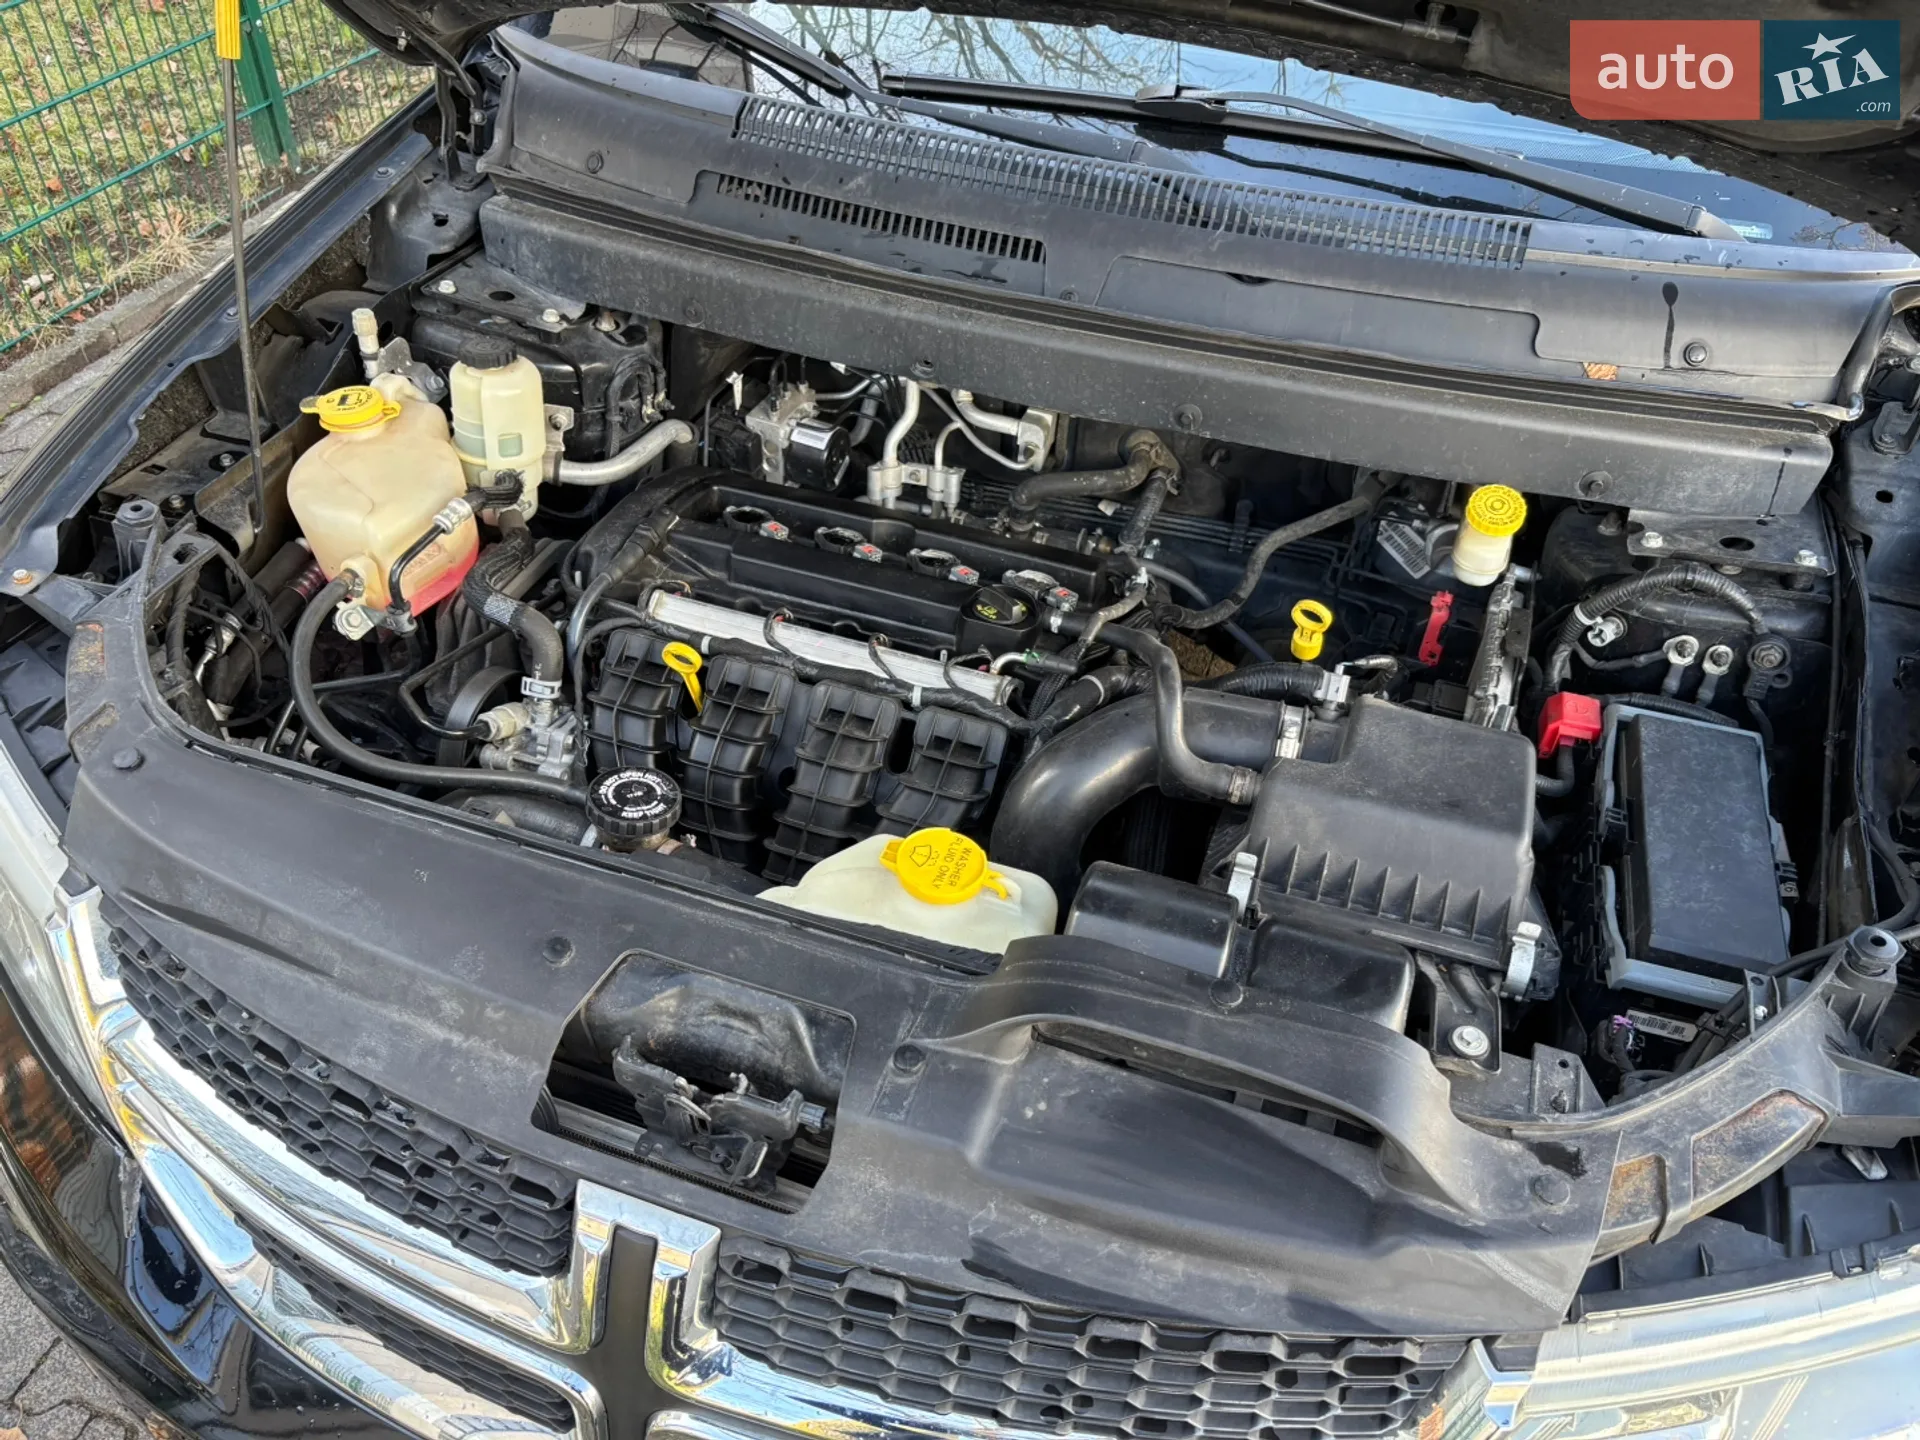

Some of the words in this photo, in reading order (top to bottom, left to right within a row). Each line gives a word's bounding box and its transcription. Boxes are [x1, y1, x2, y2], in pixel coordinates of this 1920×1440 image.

[603, 774, 619, 786] NOT
[619, 771, 643, 779] OPEN
[645, 773, 661, 783] HOT
[644, 802, 667, 816] TIGHT
[944, 836, 964, 863] FLUID
[932, 865, 949, 889] ONLY
[949, 847, 972, 887] WASHER
